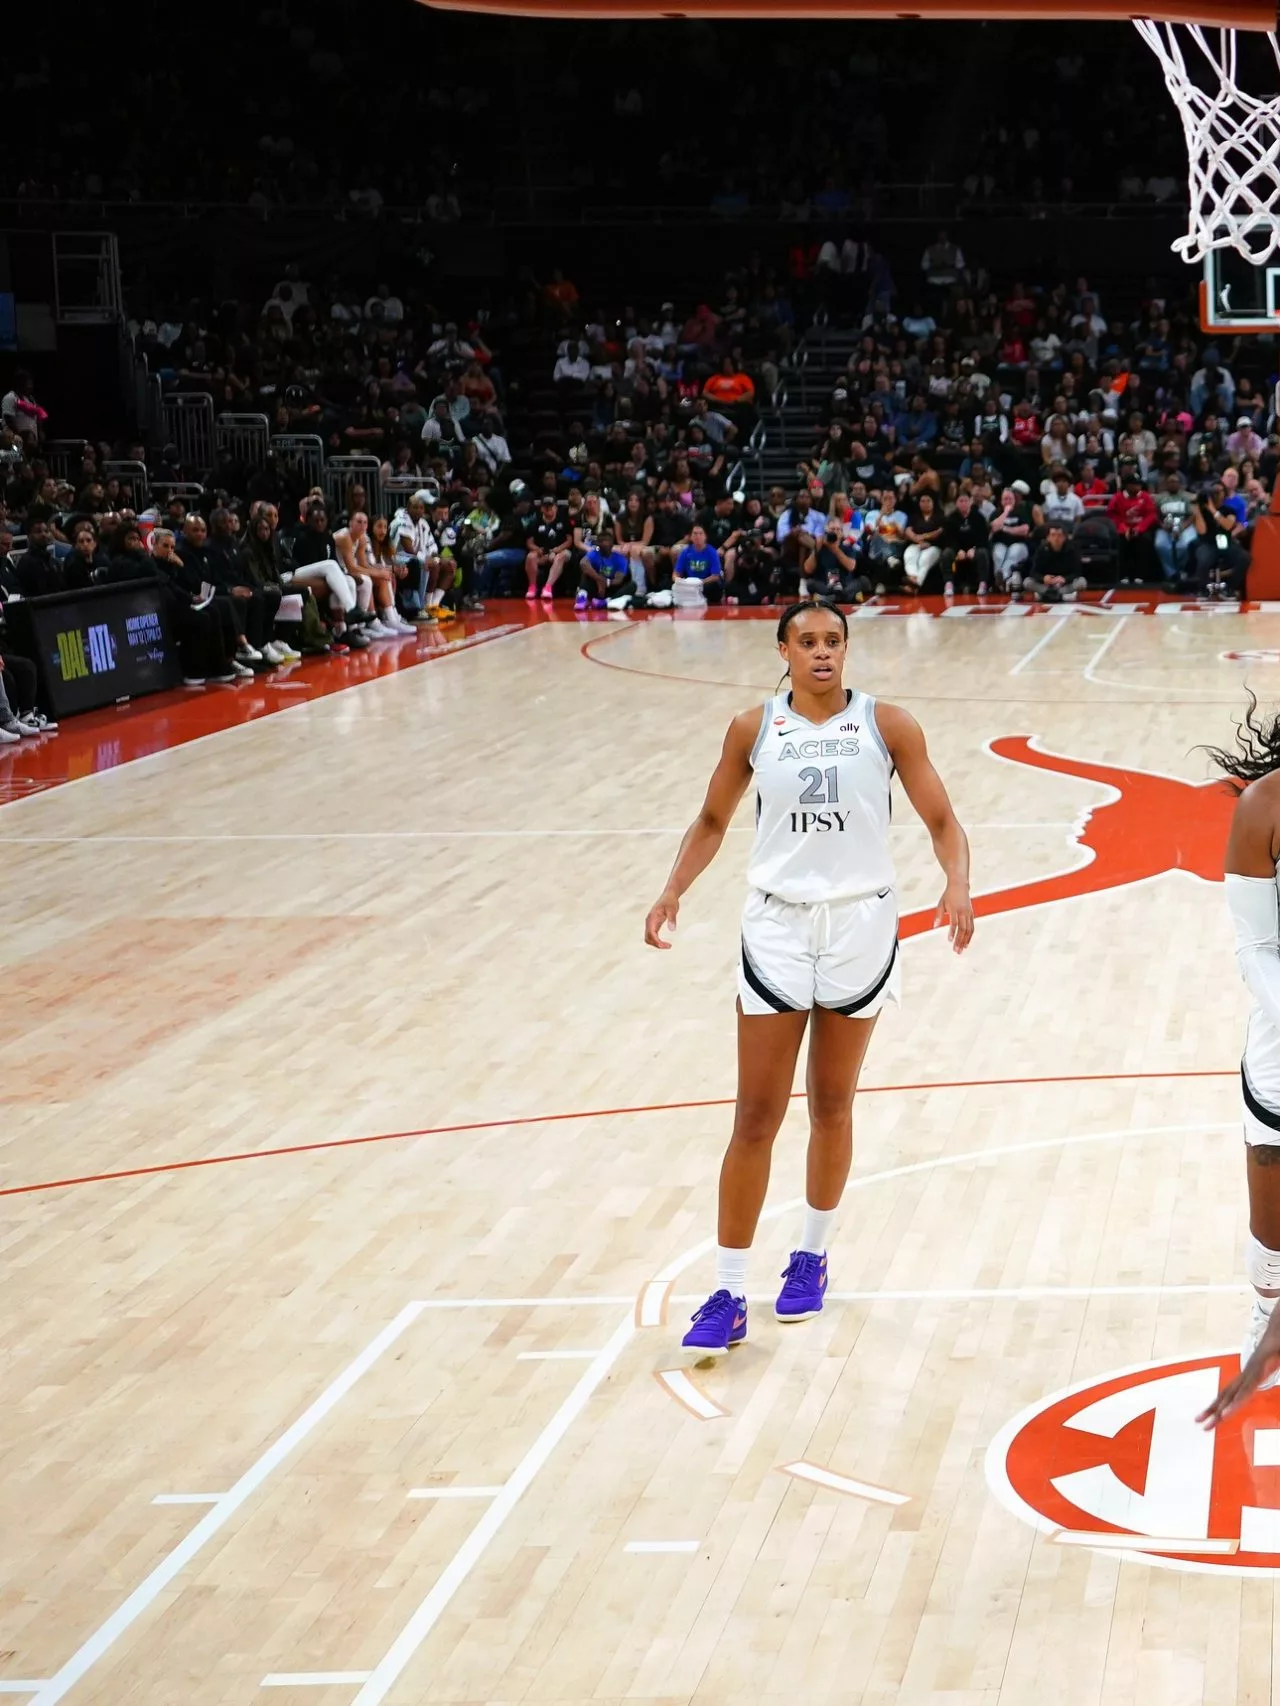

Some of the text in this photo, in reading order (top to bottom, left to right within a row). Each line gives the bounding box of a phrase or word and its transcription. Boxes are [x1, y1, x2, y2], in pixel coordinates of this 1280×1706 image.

[56, 623, 116, 681] DAL ATL
[839, 723, 860, 733] ally
[778, 738, 860, 761] ACES
[799, 766, 839, 803] 21
[790, 811, 850, 833] IPSY
